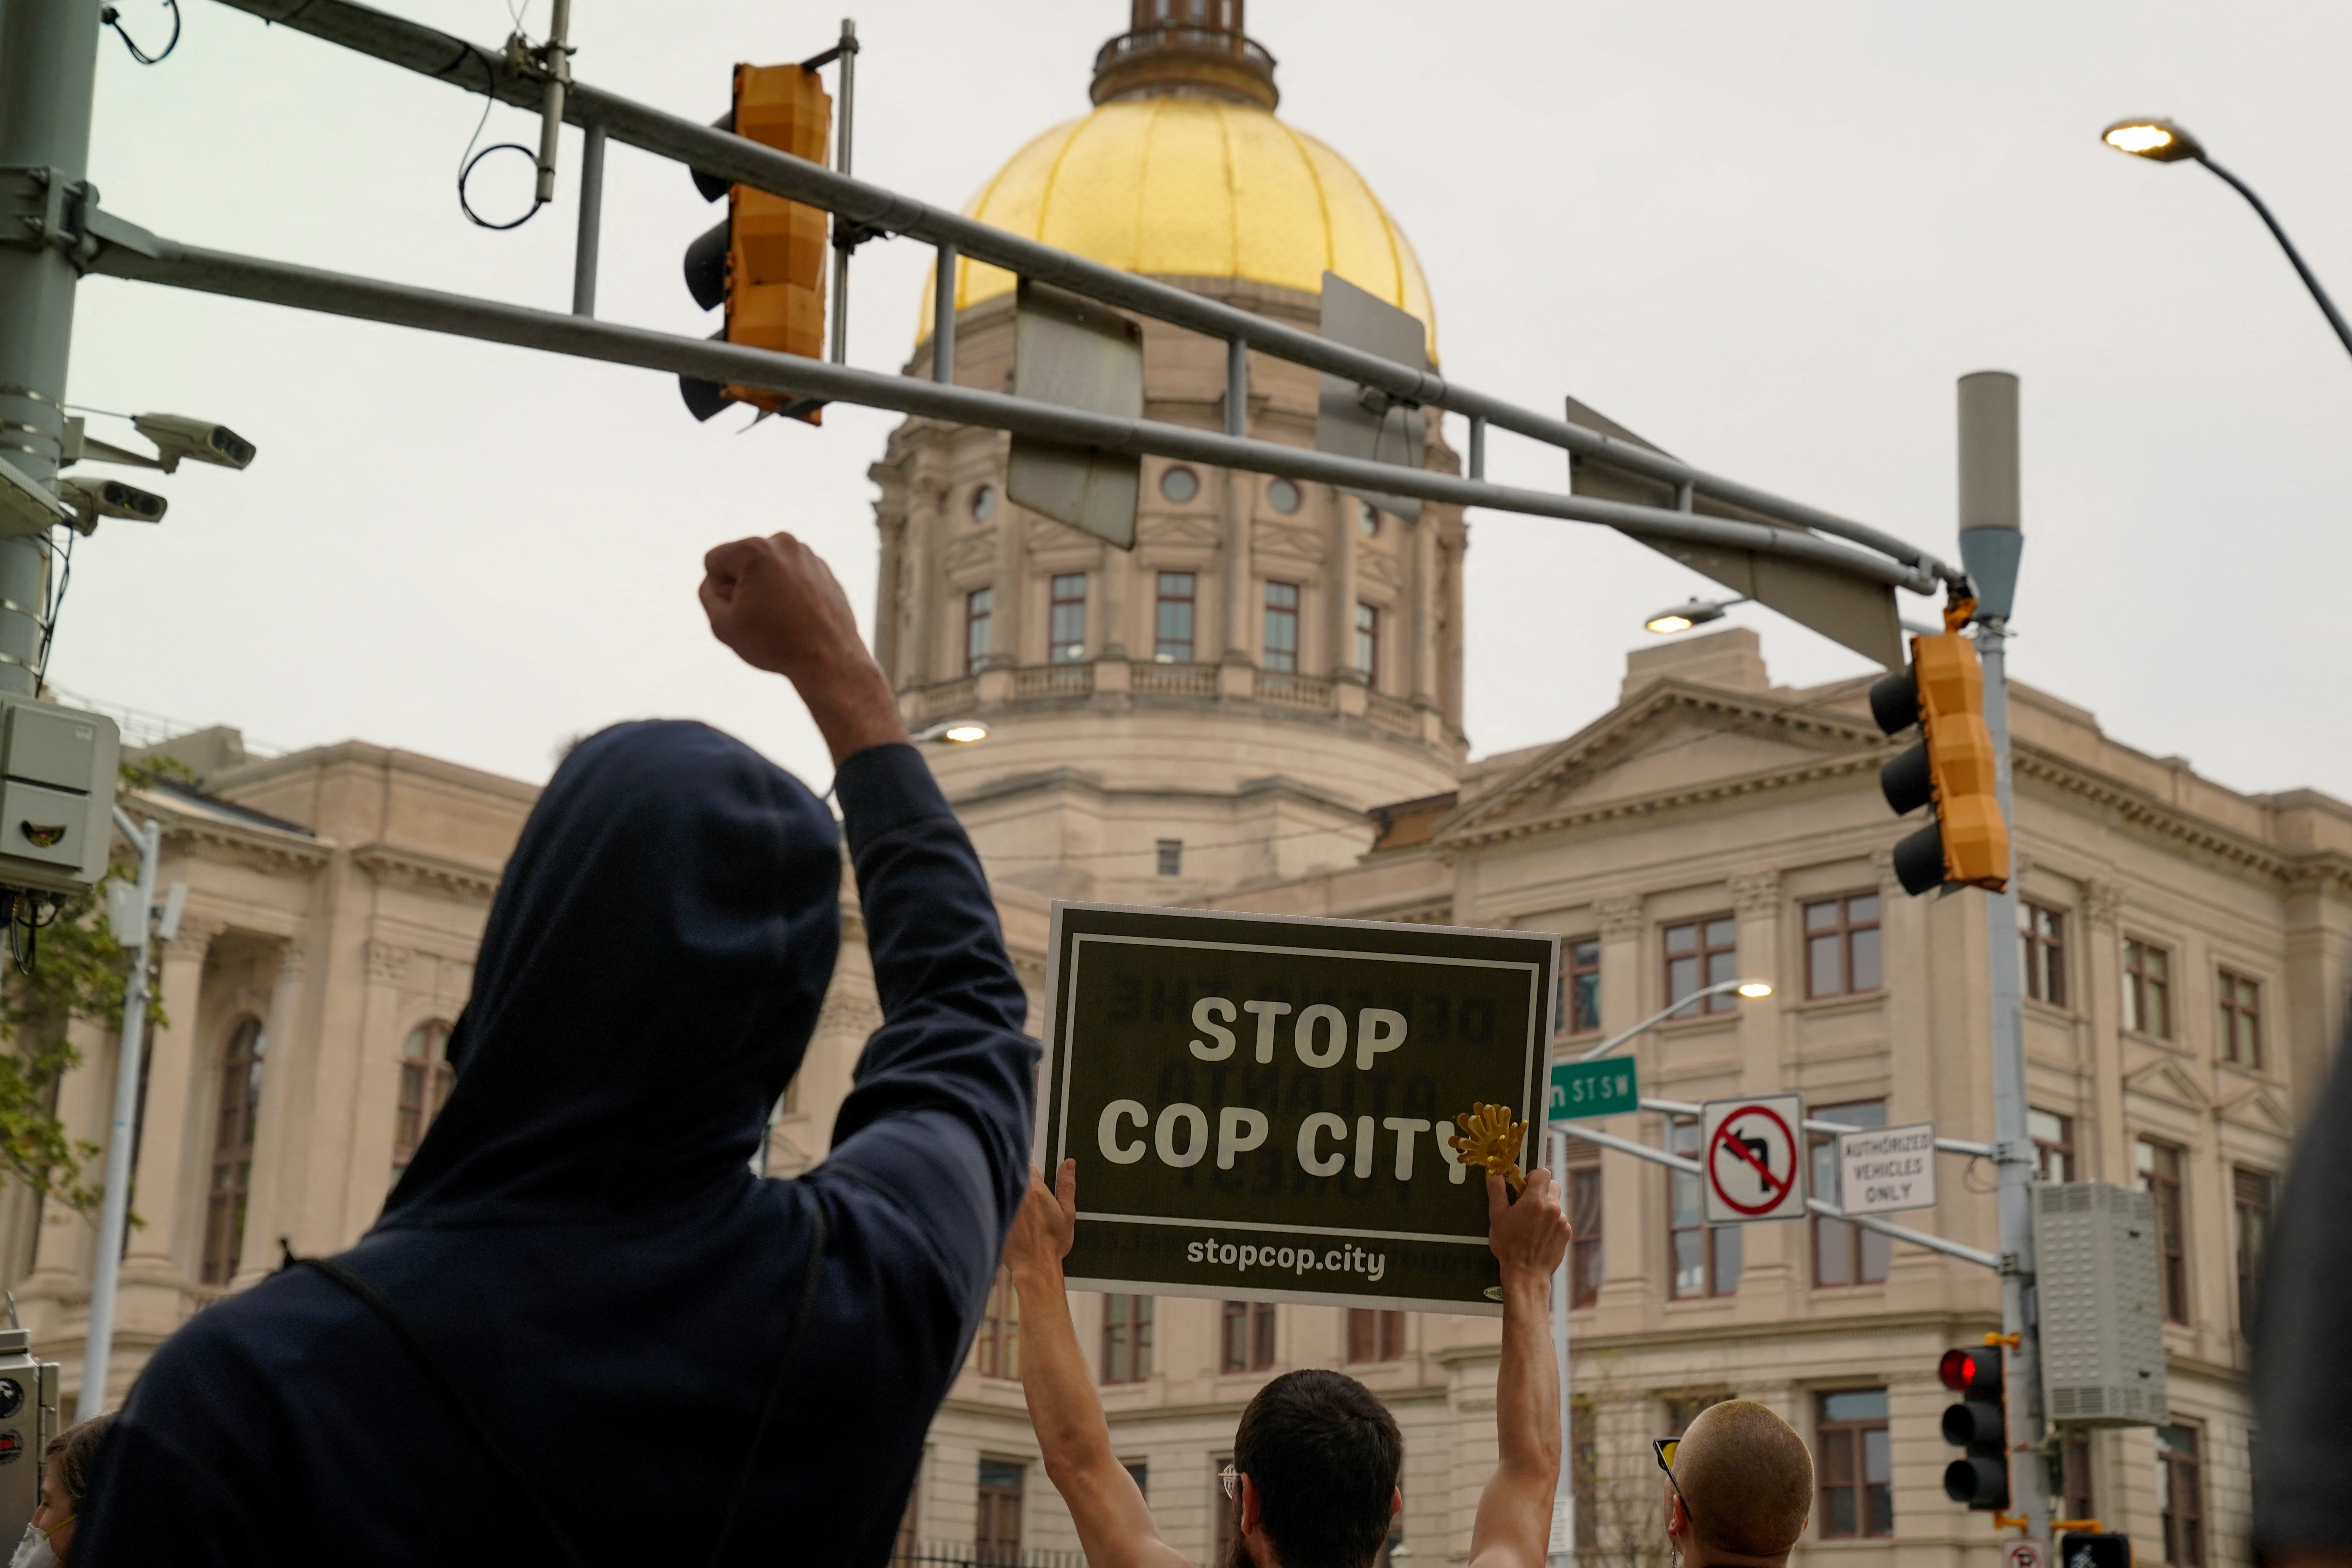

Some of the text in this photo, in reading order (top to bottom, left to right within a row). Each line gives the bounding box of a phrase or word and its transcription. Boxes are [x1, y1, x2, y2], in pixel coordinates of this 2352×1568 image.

[1189, 997, 1407, 1070] STOP
[1572, 1077, 1595, 1102] ST
[1601, 1074, 1629, 1100] SW
[1098, 1100, 1268, 1169] COP
[1297, 1112, 1467, 1184] CITY
[1846, 1133, 1931, 1157] AUTHORIZED
[1853, 1157, 1923, 1180] VEHICLES
[1865, 1183, 1913, 1204] ONLY
[1188, 1238, 1385, 1281] stopcop.city
